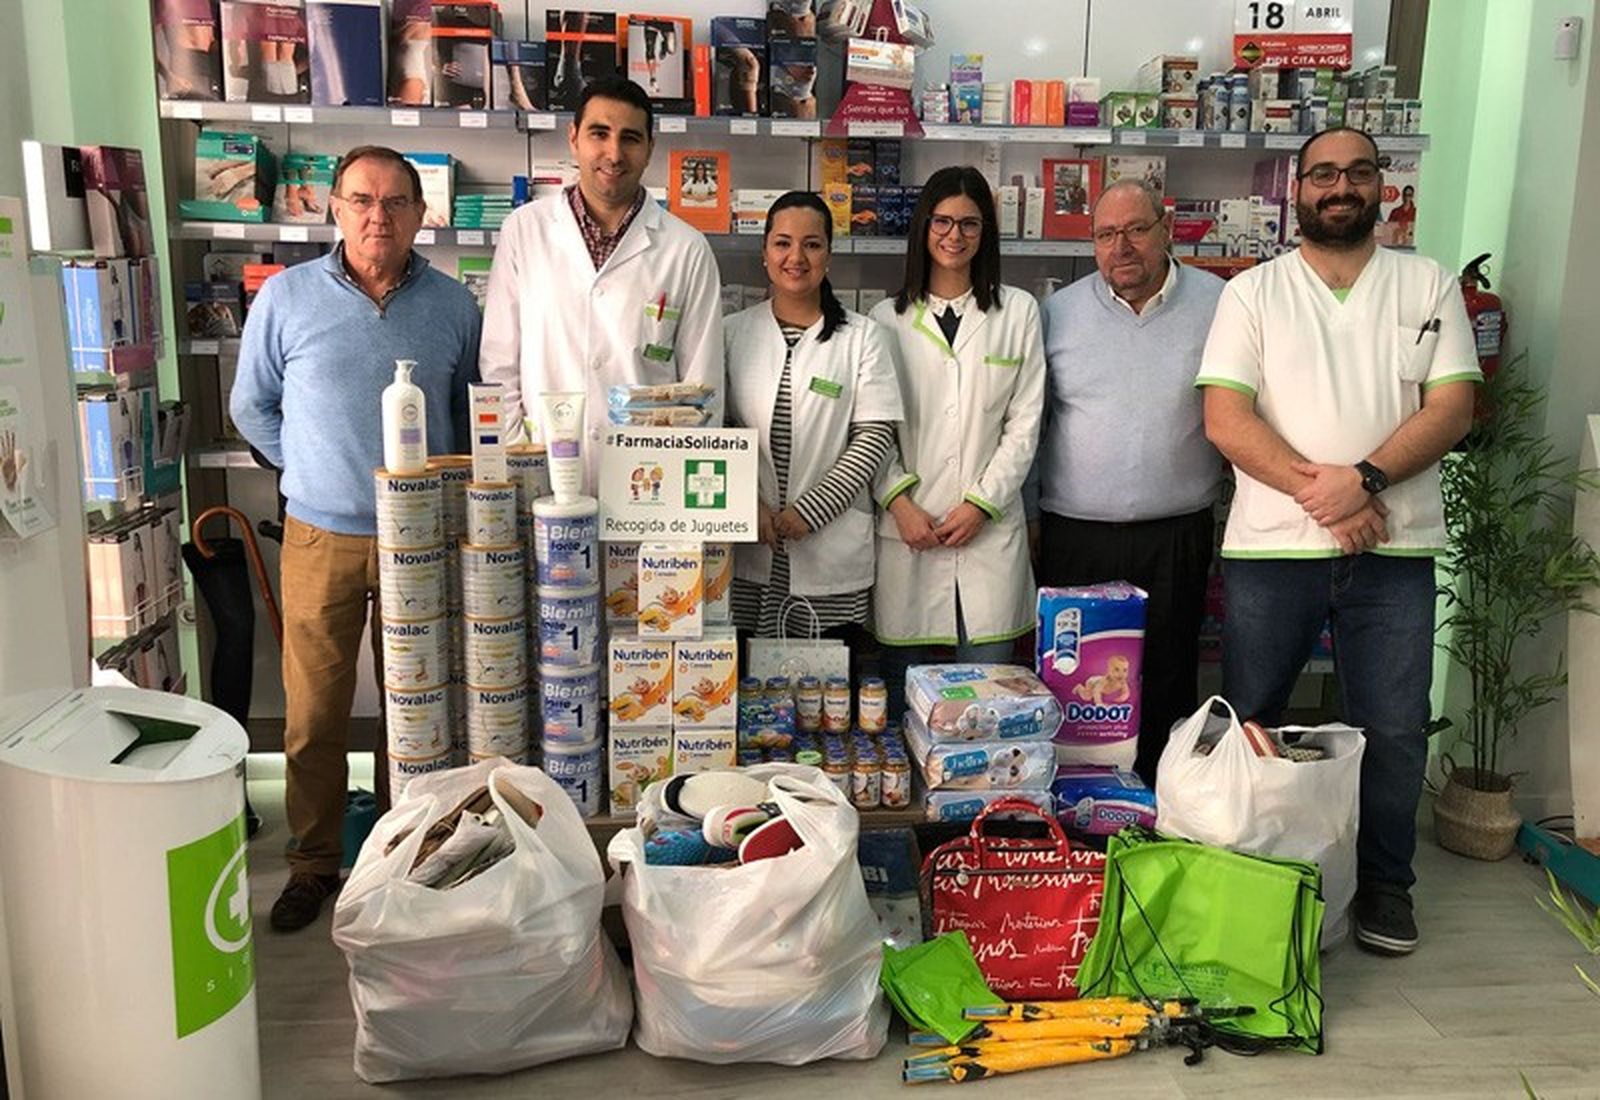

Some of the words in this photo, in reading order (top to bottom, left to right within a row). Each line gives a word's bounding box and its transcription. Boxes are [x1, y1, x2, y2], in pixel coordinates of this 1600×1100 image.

[1248, 2, 1285, 30] 18
[1305, 7, 1341, 18] ABRIL
[1291, 55, 1315, 65] CITA
[878, 106, 895, 115] que
[606, 434, 749, 450] #FarmaciaSolidaria
[388, 479, 441, 493] Novalac
[469, 491, 514, 501] Novalac
[605, 517, 666, 535] Recogida
[670, 519, 687, 532] de
[691, 518, 749, 536] Juguetes
[580, 545, 591, 569] 1
[642, 557, 698, 569] Nutribén
[566, 625, 578, 650] 1
[613, 648, 669, 661] Nutribén
[678, 648, 733, 661] Nutribén
[613, 662, 624, 673] 8
[679, 662, 689, 673] 8
[571, 703, 583, 728] 1
[1067, 704, 1131, 722] DODOT
[613, 735, 669, 749] Nutribén
[678, 738, 732, 750] Nutribén
[678, 753, 688, 763] 8
[575, 780, 588, 803] 1
[1098, 809, 1139, 823] DODOT
